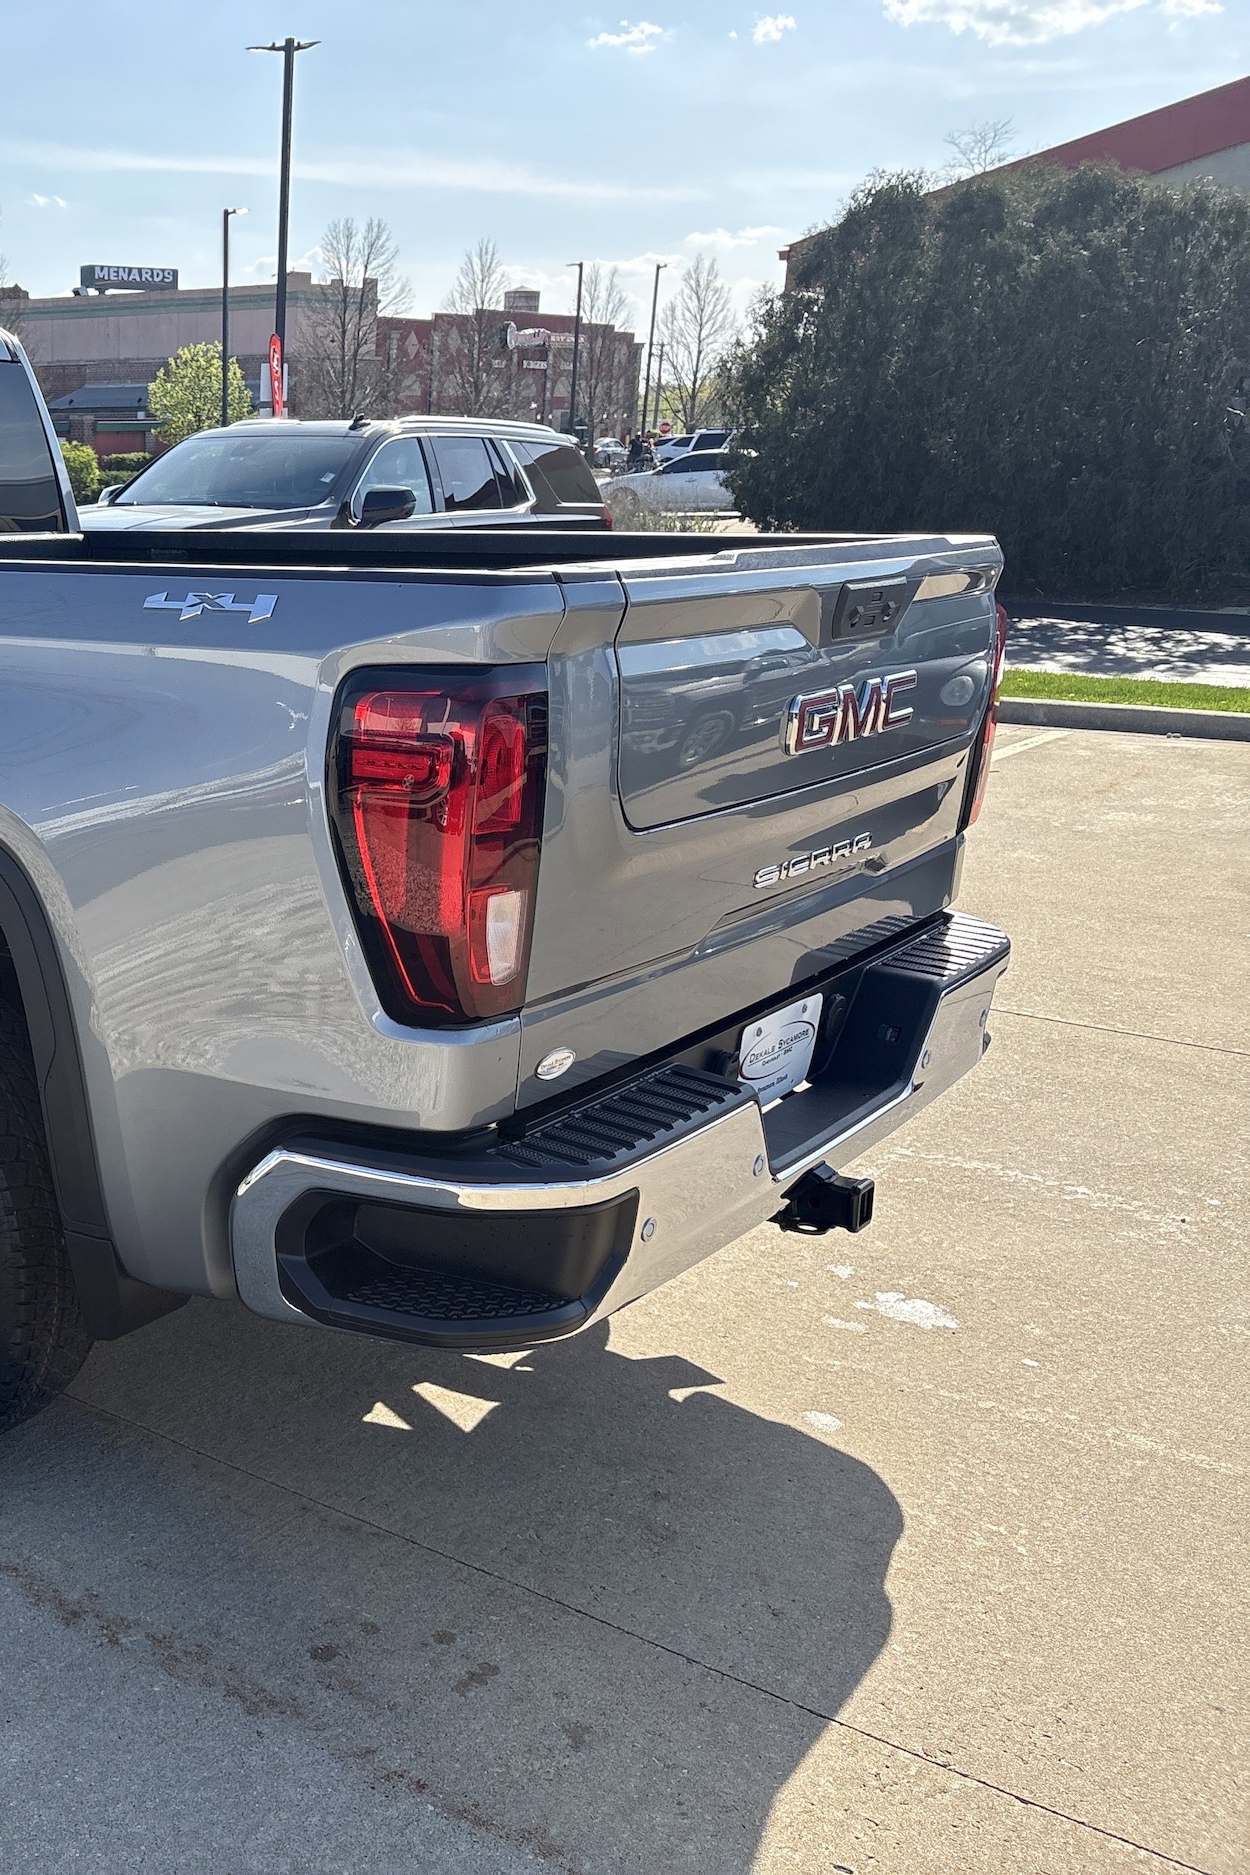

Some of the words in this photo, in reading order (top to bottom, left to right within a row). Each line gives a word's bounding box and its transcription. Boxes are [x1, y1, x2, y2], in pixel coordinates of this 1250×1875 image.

[94, 266, 174, 283] MENARDS
[780, 669, 918, 757] GMC
[753, 831, 872, 889] SIERRA
